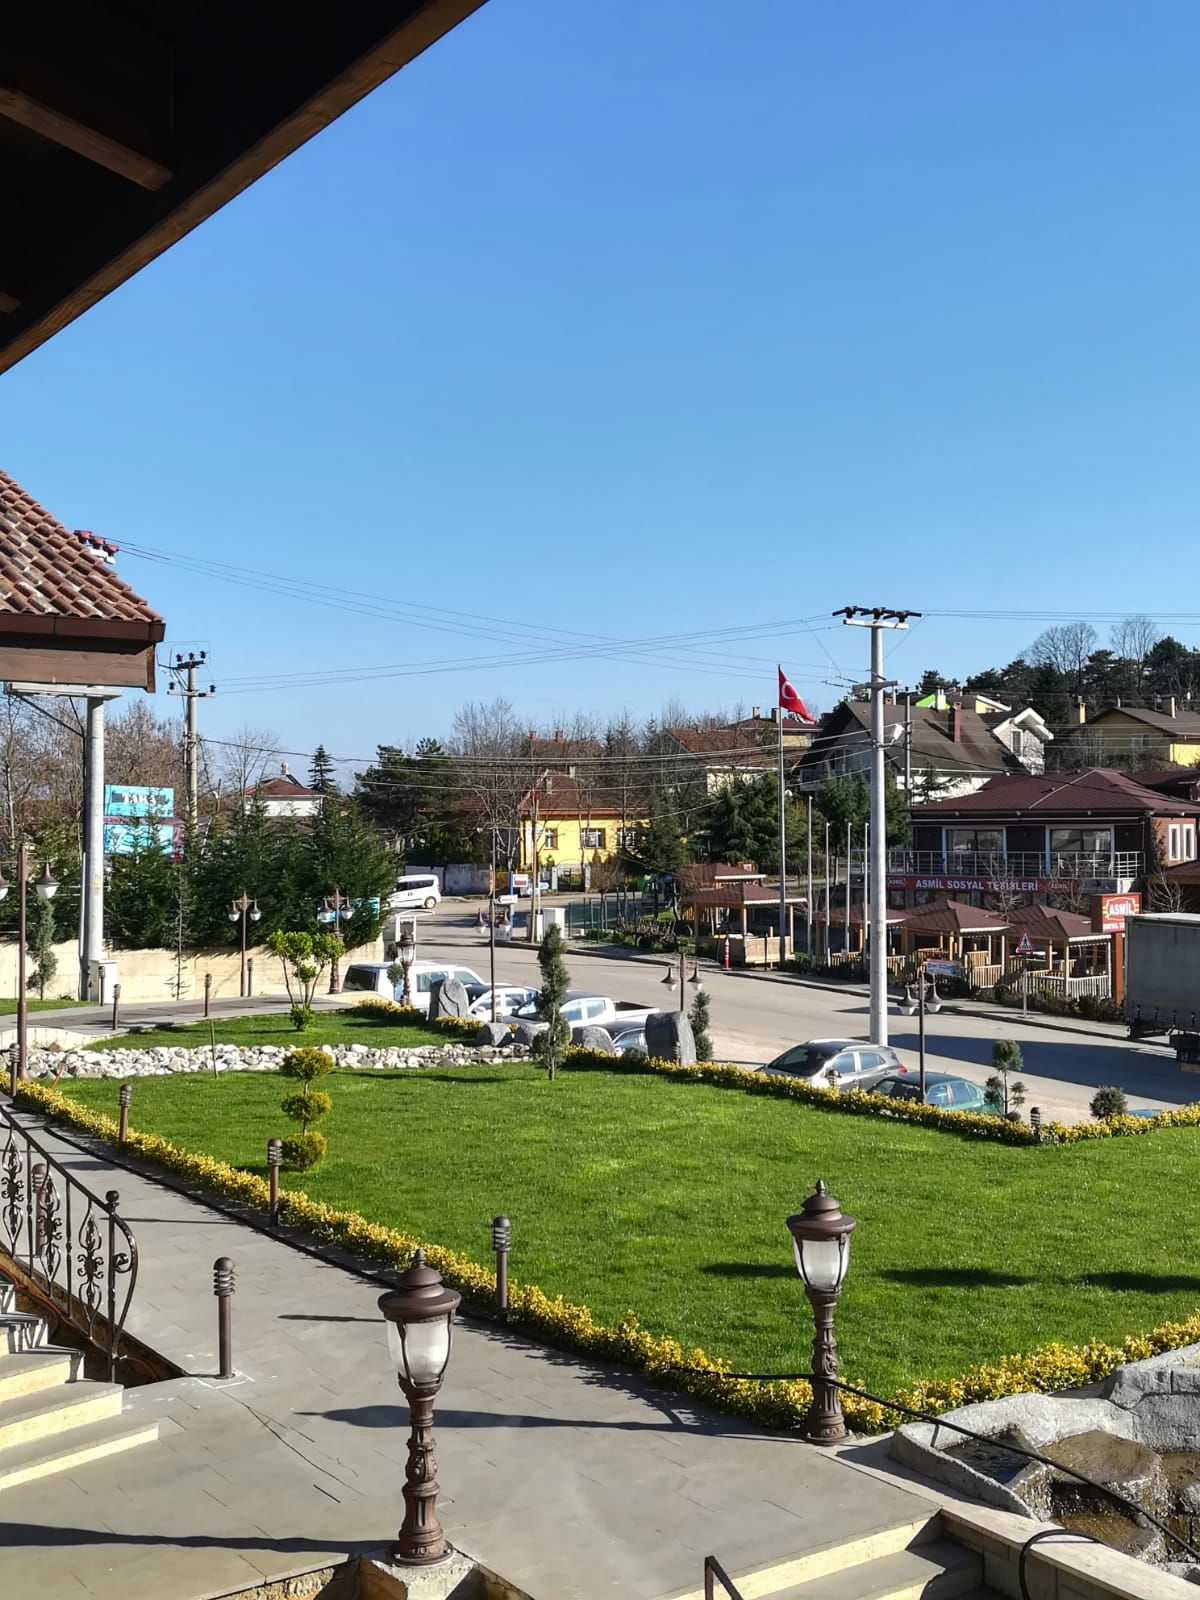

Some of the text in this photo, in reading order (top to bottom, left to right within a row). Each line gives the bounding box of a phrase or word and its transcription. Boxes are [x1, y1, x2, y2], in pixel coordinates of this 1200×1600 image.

[915, 878, 944, 889] ASMİL
[947, 880, 984, 889] SOSYAL
[1109, 900, 1134, 916] ASMİL
